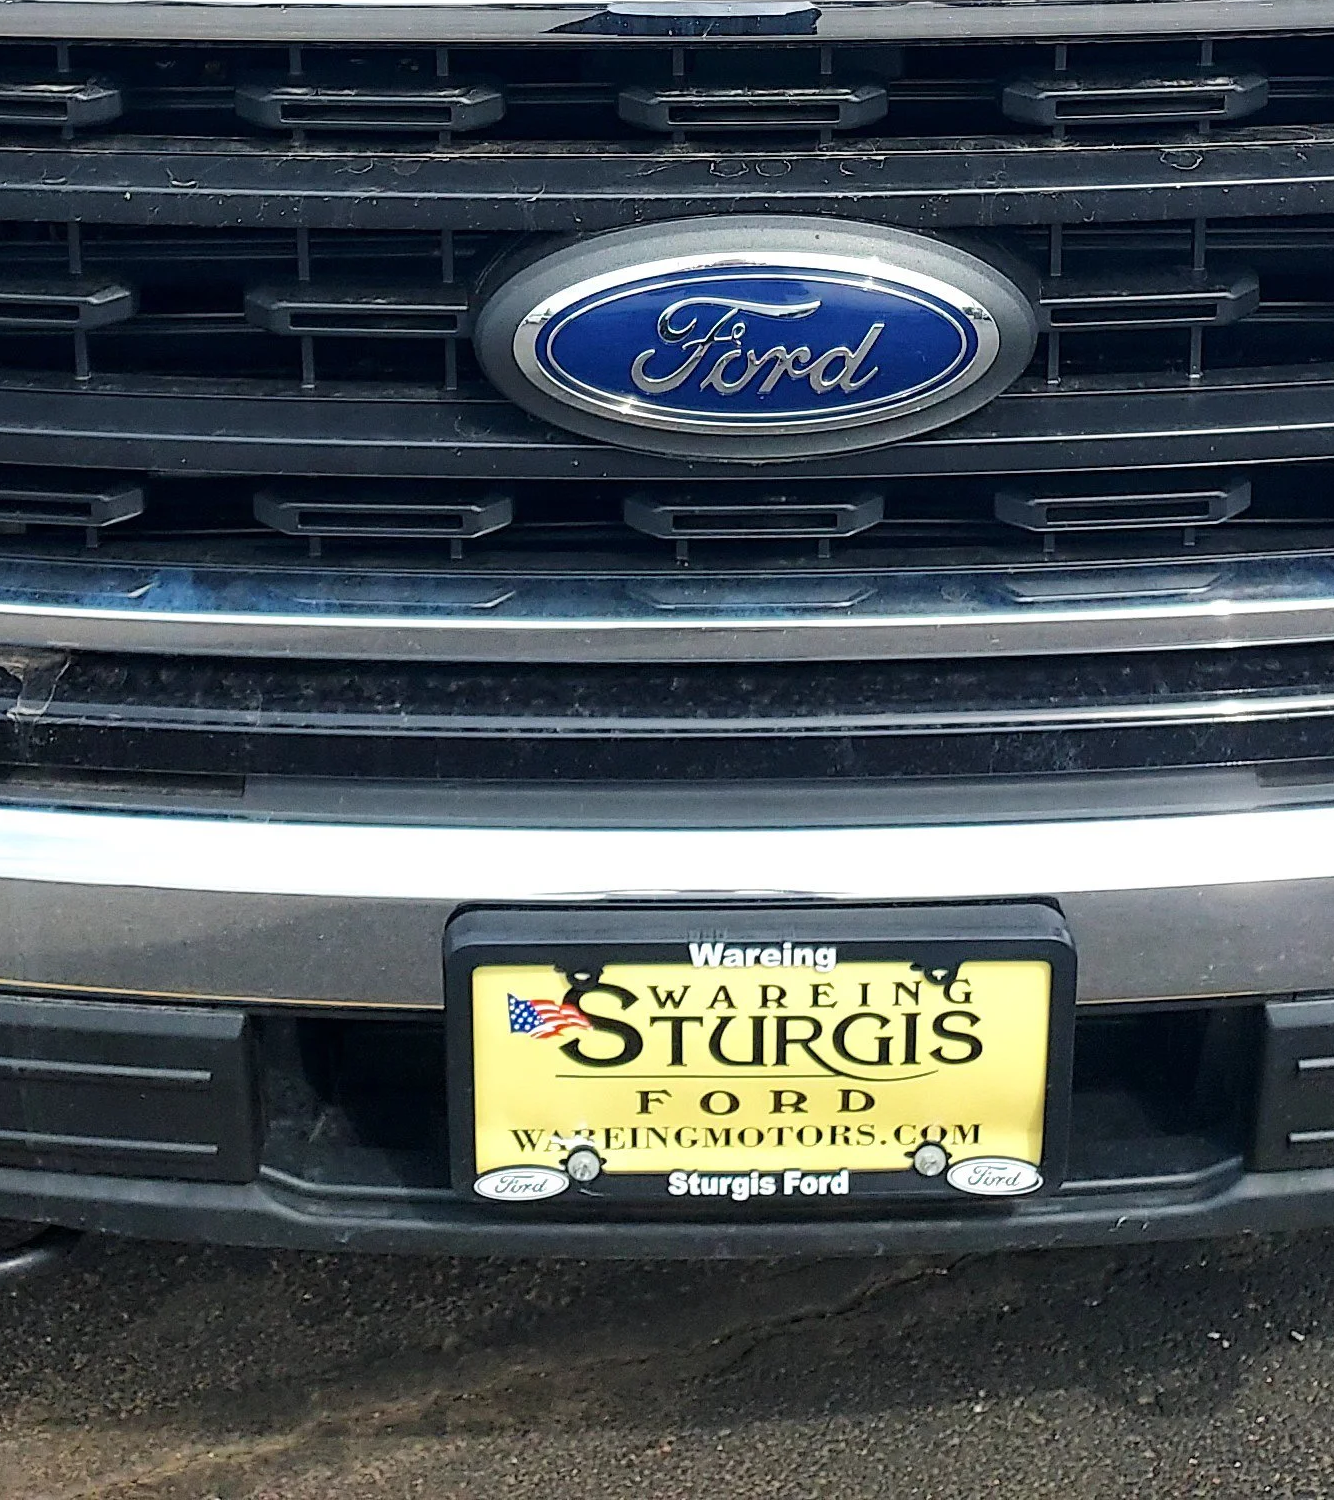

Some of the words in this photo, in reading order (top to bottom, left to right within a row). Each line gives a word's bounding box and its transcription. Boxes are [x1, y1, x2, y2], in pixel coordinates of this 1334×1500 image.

[631, 296, 886, 395] Ford
[688, 941, 837, 972] Wareing
[647, 978, 973, 1009] WAREING
[559, 982, 983, 1082] STURGIS
[635, 1088, 877, 1116] FORD
[494, 1175, 548, 1194] Ford
[668, 1170, 776, 1197] Sturgis
[783, 1169, 850, 1196] Ford
[968, 1165, 1021, 1186] Ford
